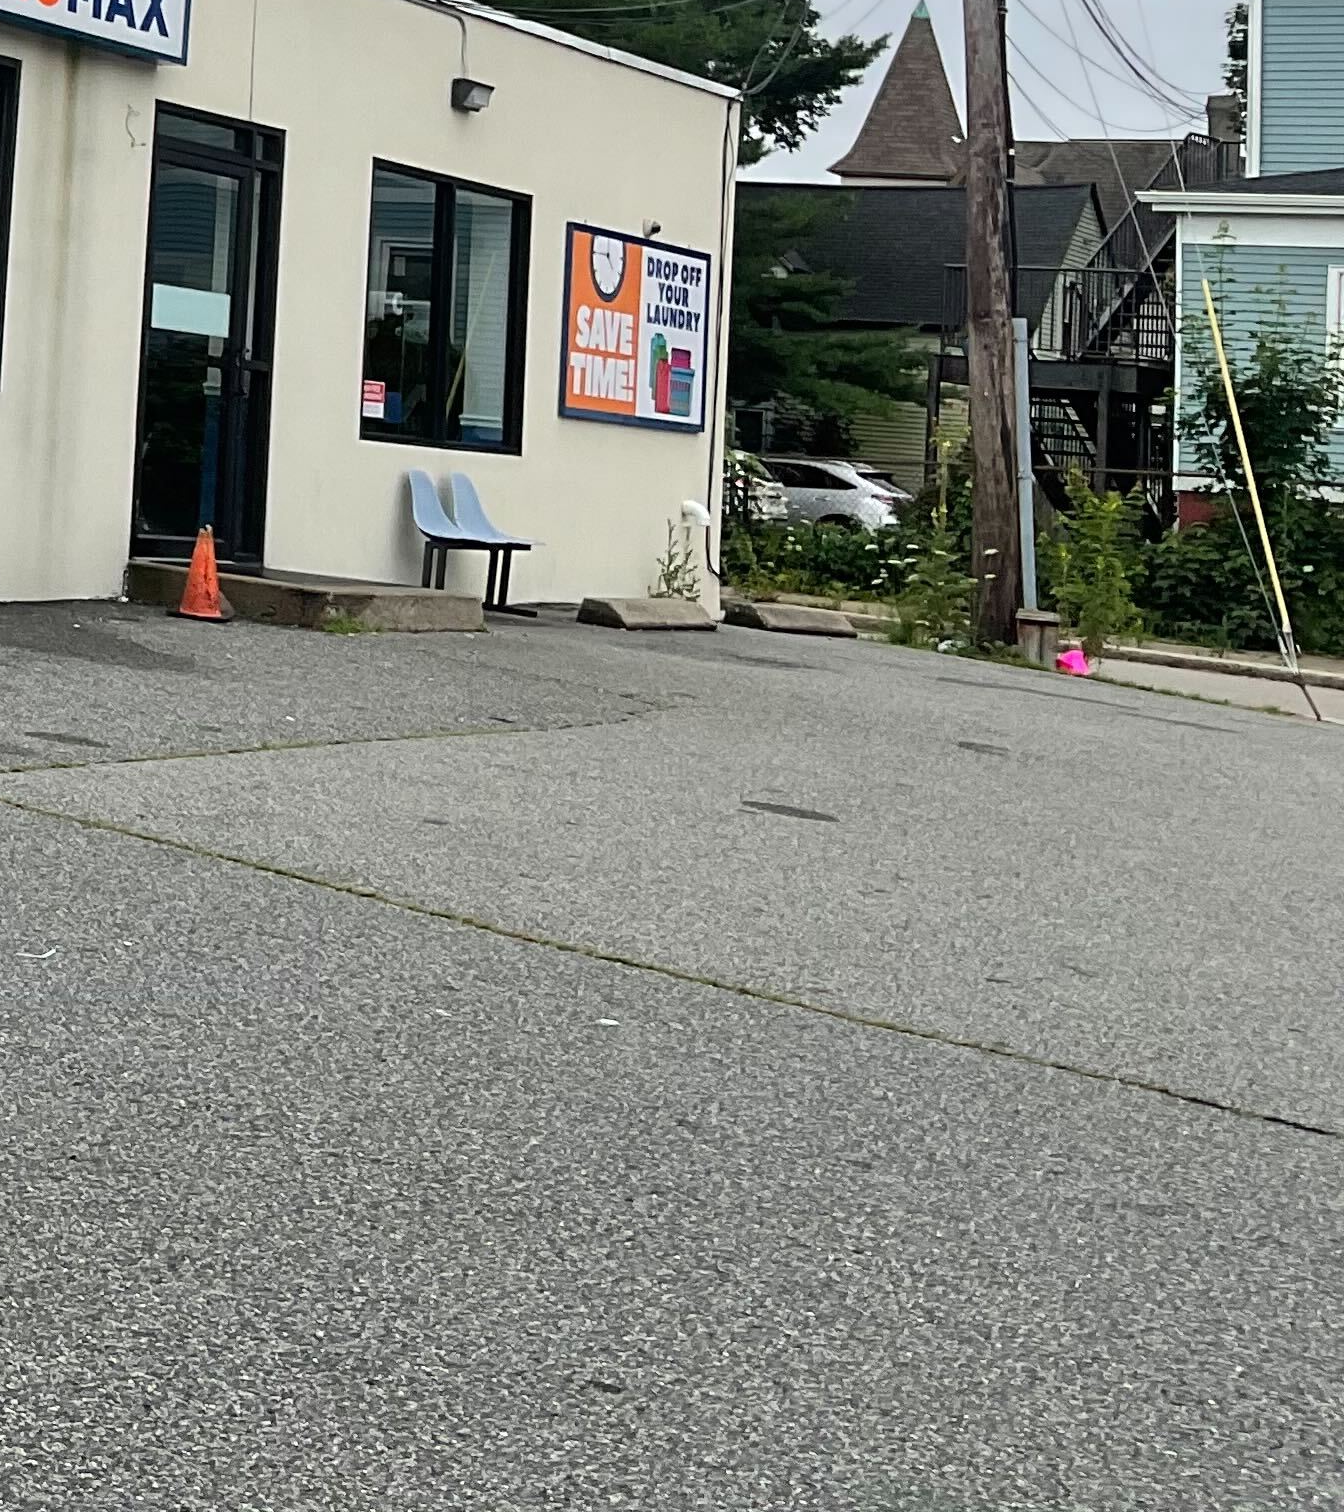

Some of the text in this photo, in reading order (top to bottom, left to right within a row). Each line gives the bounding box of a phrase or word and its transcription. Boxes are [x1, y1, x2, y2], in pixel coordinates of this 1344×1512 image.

[647, 256, 702, 287] DROP OFF
[658, 282, 689, 308] YOUR
[575, 304, 634, 356] SAVE
[646, 302, 701, 333] LAUNDRY
[569, 352, 635, 402] TIME!
